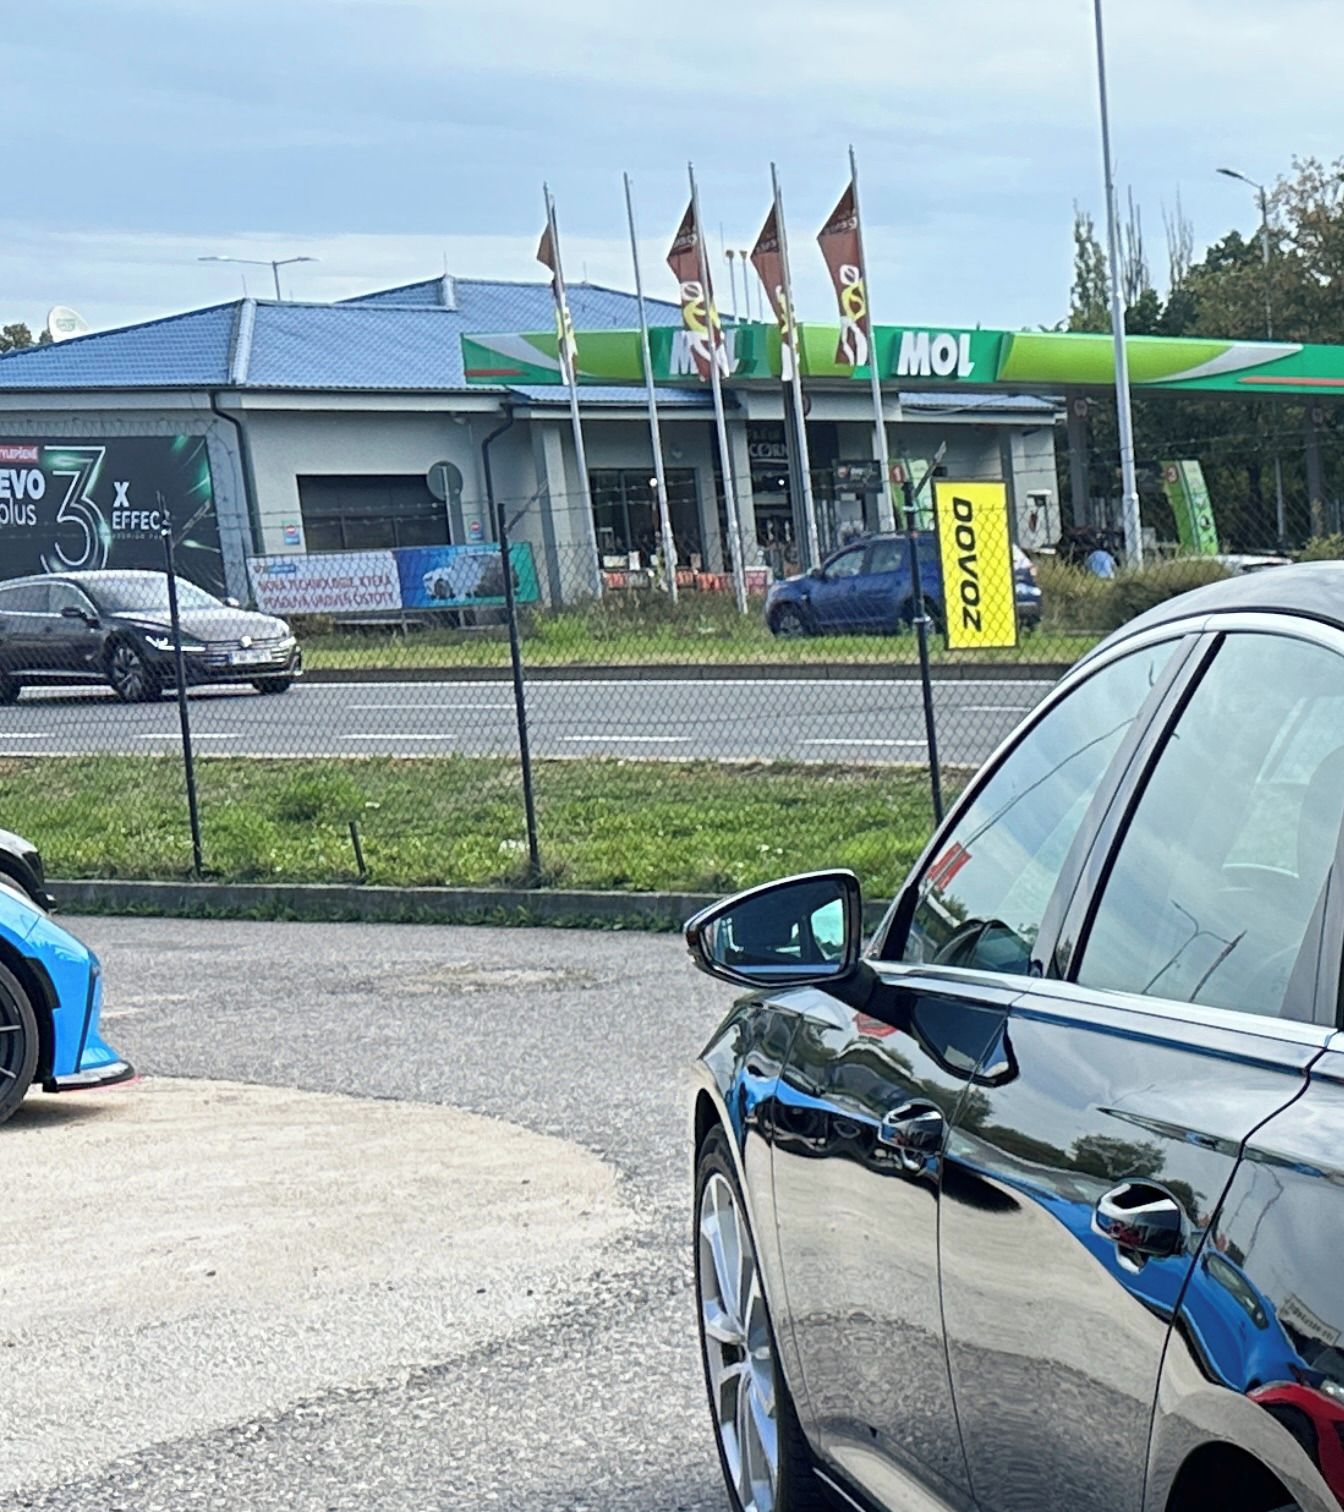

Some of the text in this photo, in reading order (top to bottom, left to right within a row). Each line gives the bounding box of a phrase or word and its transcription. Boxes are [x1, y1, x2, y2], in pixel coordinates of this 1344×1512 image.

[897, 330, 975, 377] MOL
[113, 481, 130, 508] X
[112, 510, 163, 530] EFFEC
[952, 496, 983, 633] DOVOZ
